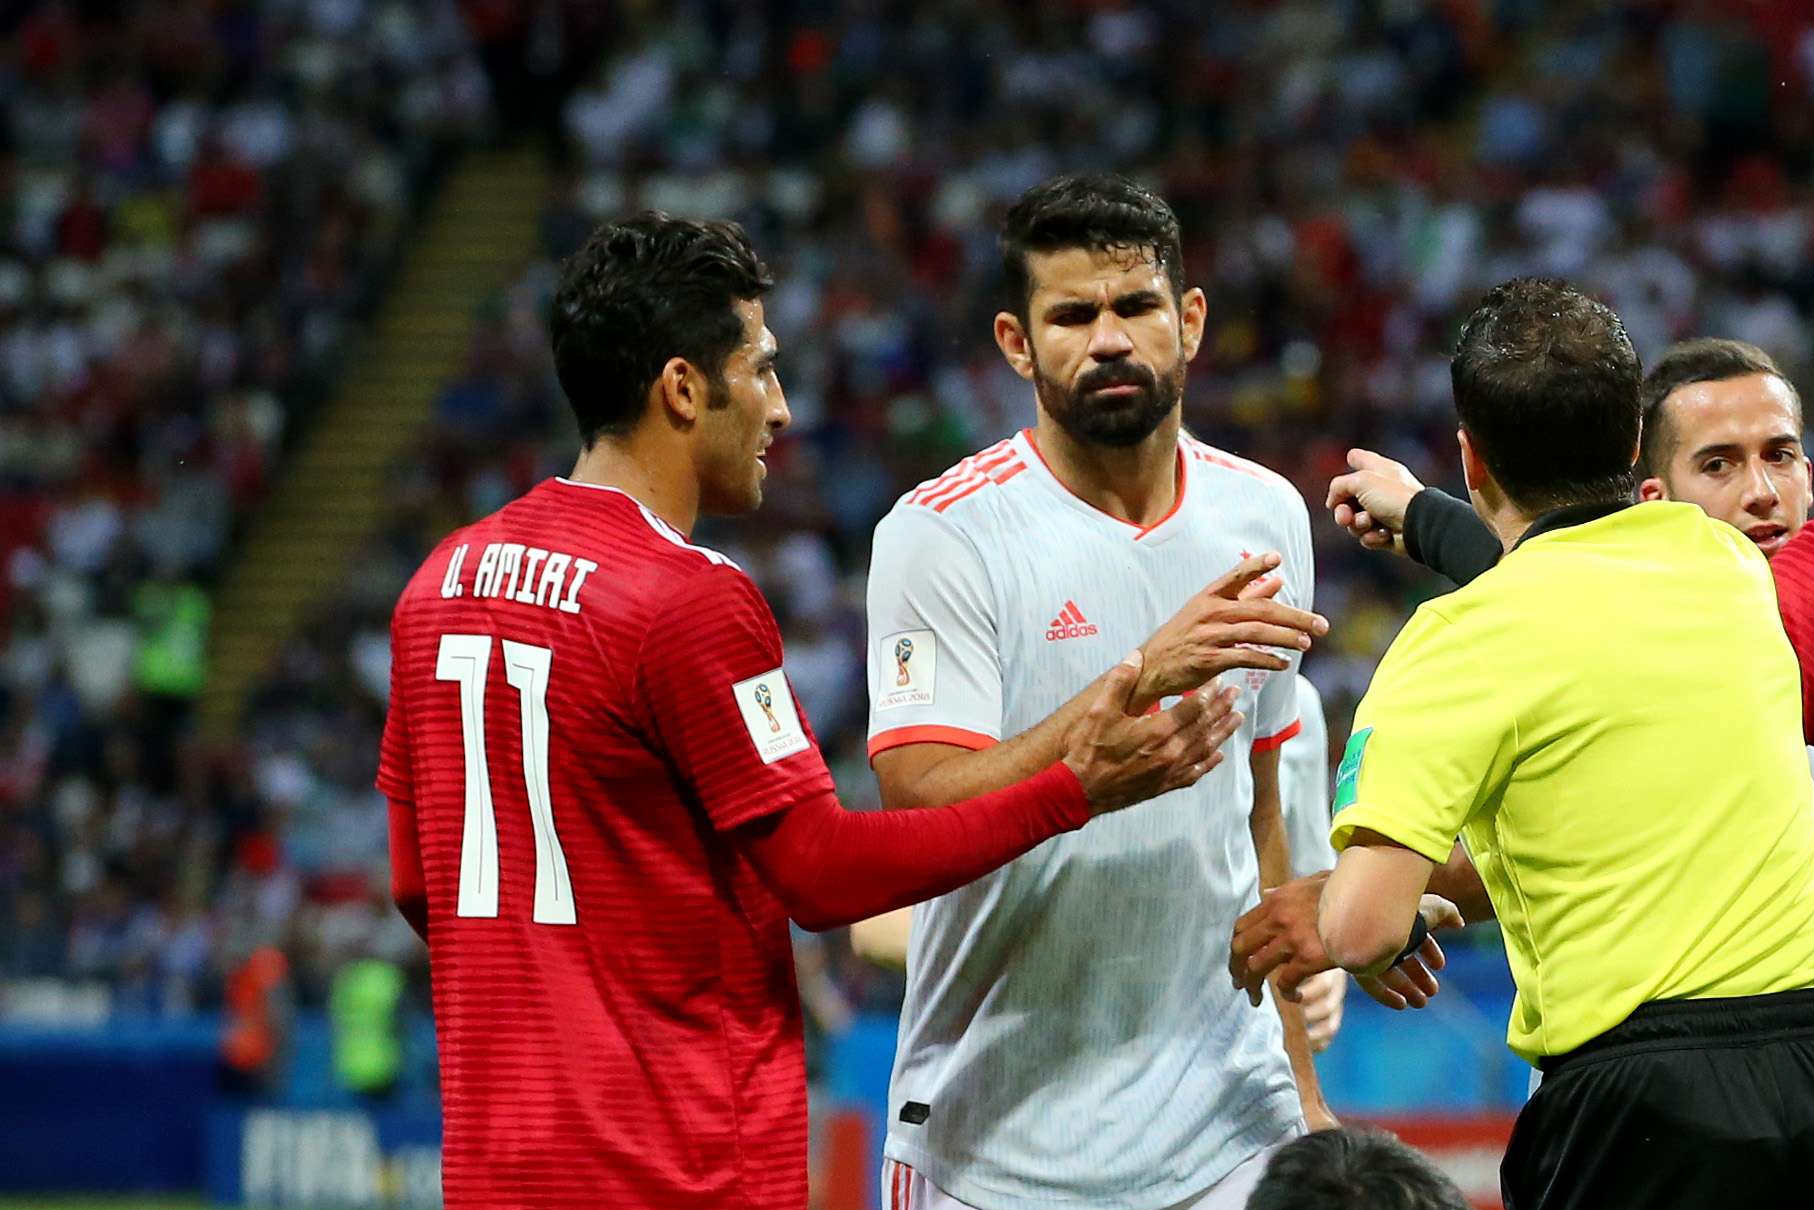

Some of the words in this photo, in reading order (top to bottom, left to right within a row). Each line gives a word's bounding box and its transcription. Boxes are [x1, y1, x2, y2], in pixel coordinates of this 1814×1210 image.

[473, 543, 598, 614] AMIRI
[1046, 624, 1097, 641] adidas
[435, 634, 577, 925] 11
